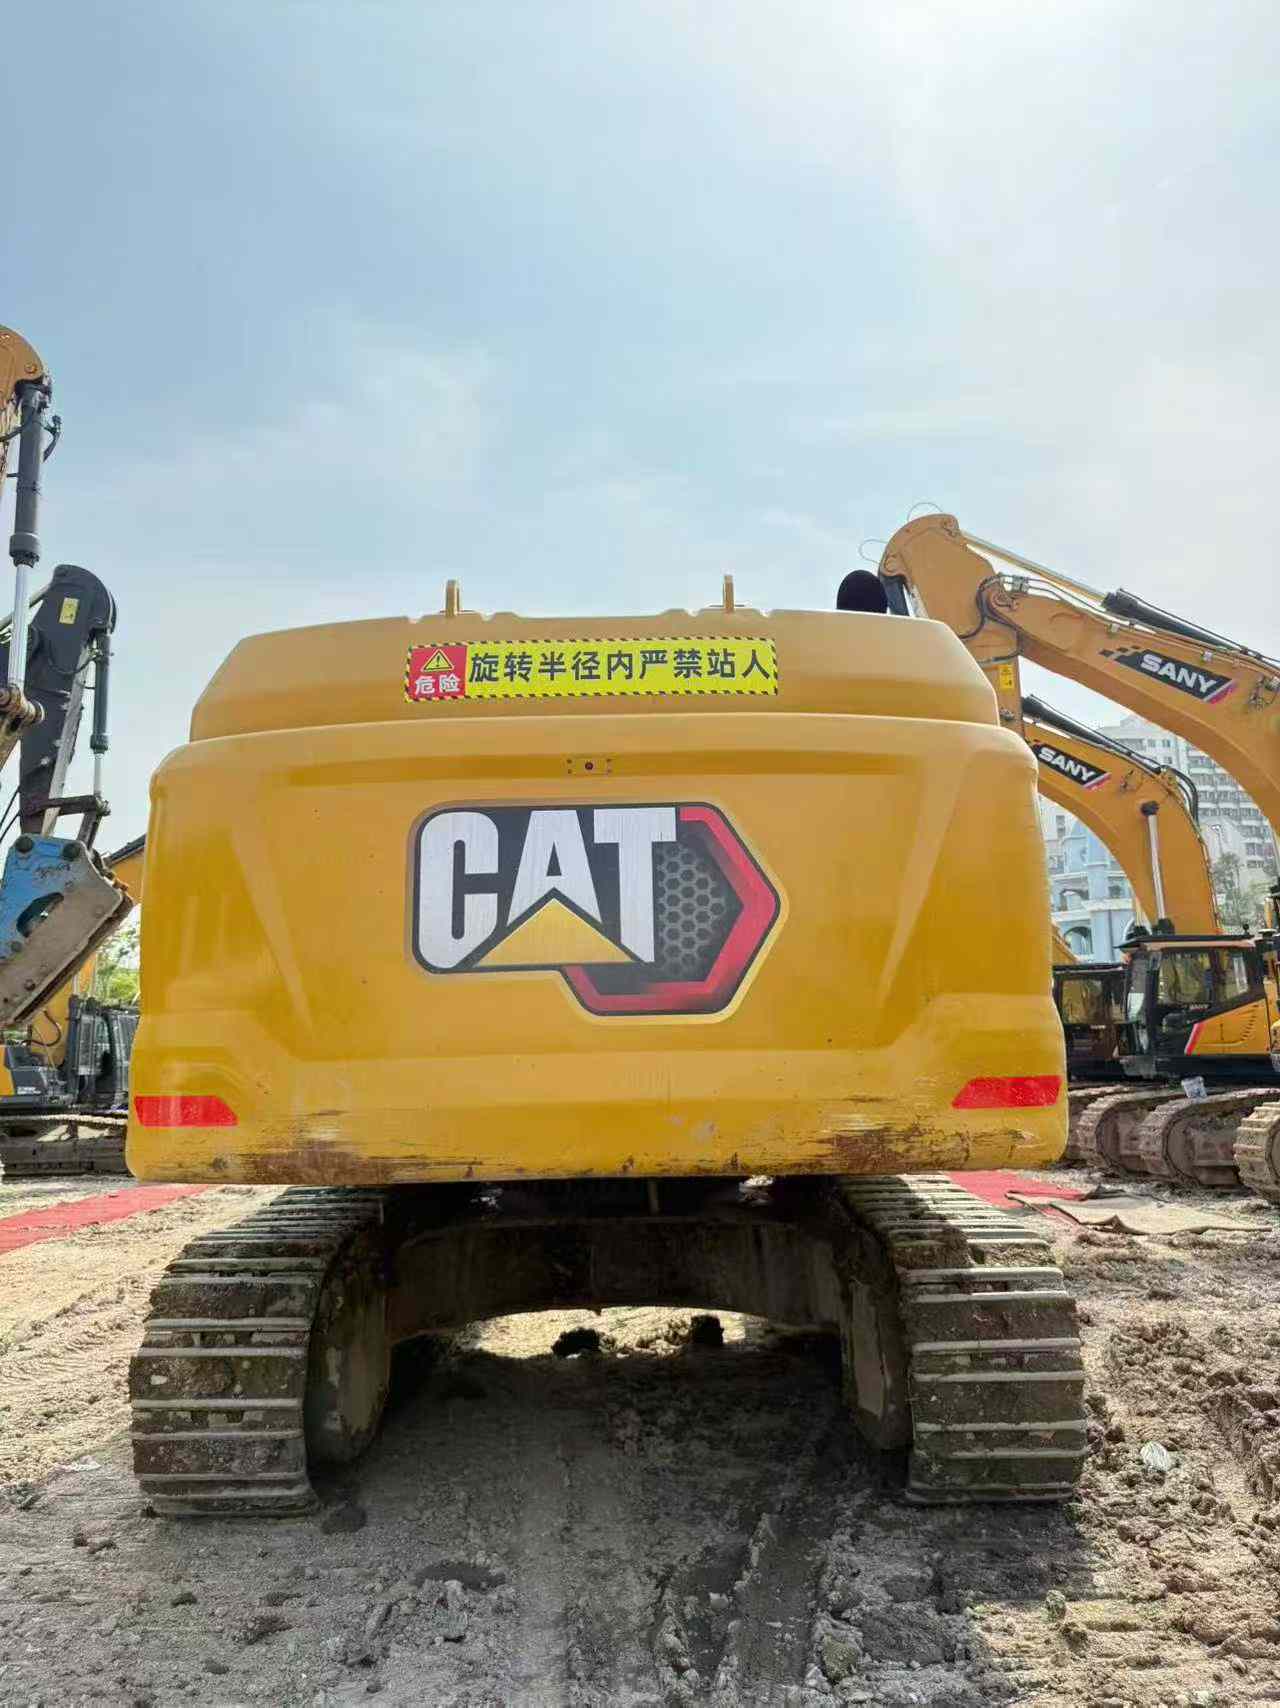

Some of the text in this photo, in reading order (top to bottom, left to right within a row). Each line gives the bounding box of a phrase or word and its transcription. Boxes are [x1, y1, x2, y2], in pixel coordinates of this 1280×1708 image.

[469, 649, 770, 682] 旋转半径内严禁站人
[1140, 653, 1218, 693] SANY
[414, 674, 460, 694] 危险
[1038, 747, 1095, 782] SANY
[419, 806, 677, 969] CAT
